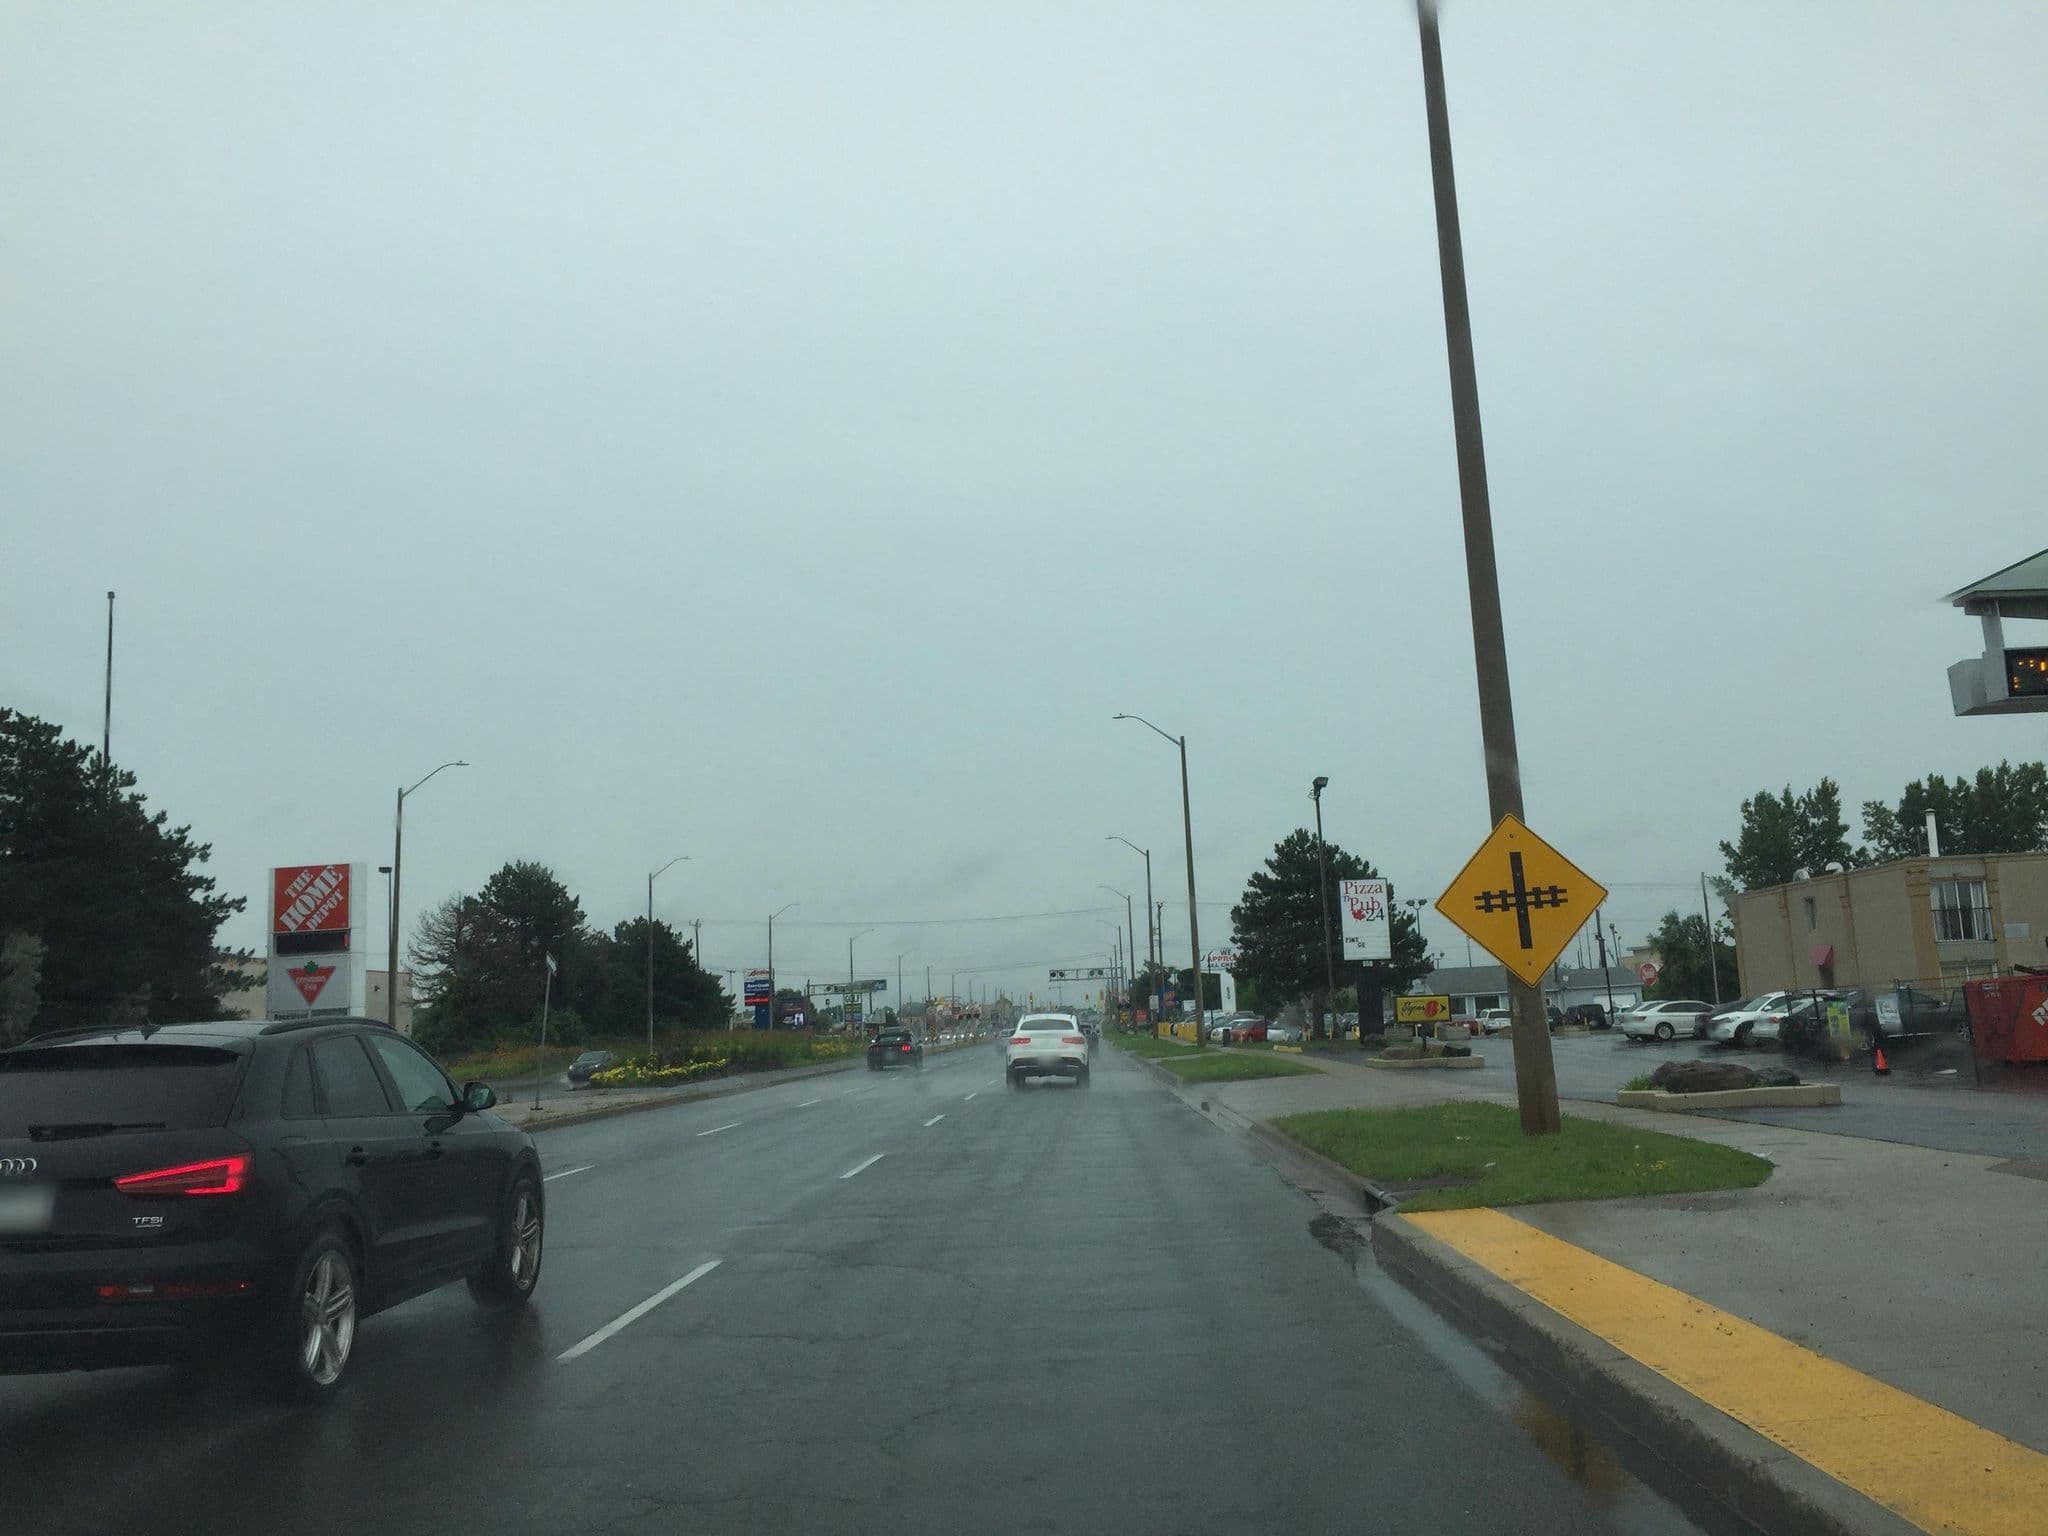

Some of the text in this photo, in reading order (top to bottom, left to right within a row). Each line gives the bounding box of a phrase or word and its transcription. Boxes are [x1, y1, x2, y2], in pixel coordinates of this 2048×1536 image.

[285, 869, 313, 898] THE
[1344, 882, 1383, 894] Pizza
[280, 865, 344, 932] HOME
[1350, 897, 1380, 911] Pub
[306, 889, 344, 930] DEPOT
[1366, 907, 1384, 921] 24
[132, 1216, 163, 1224] TFSI
